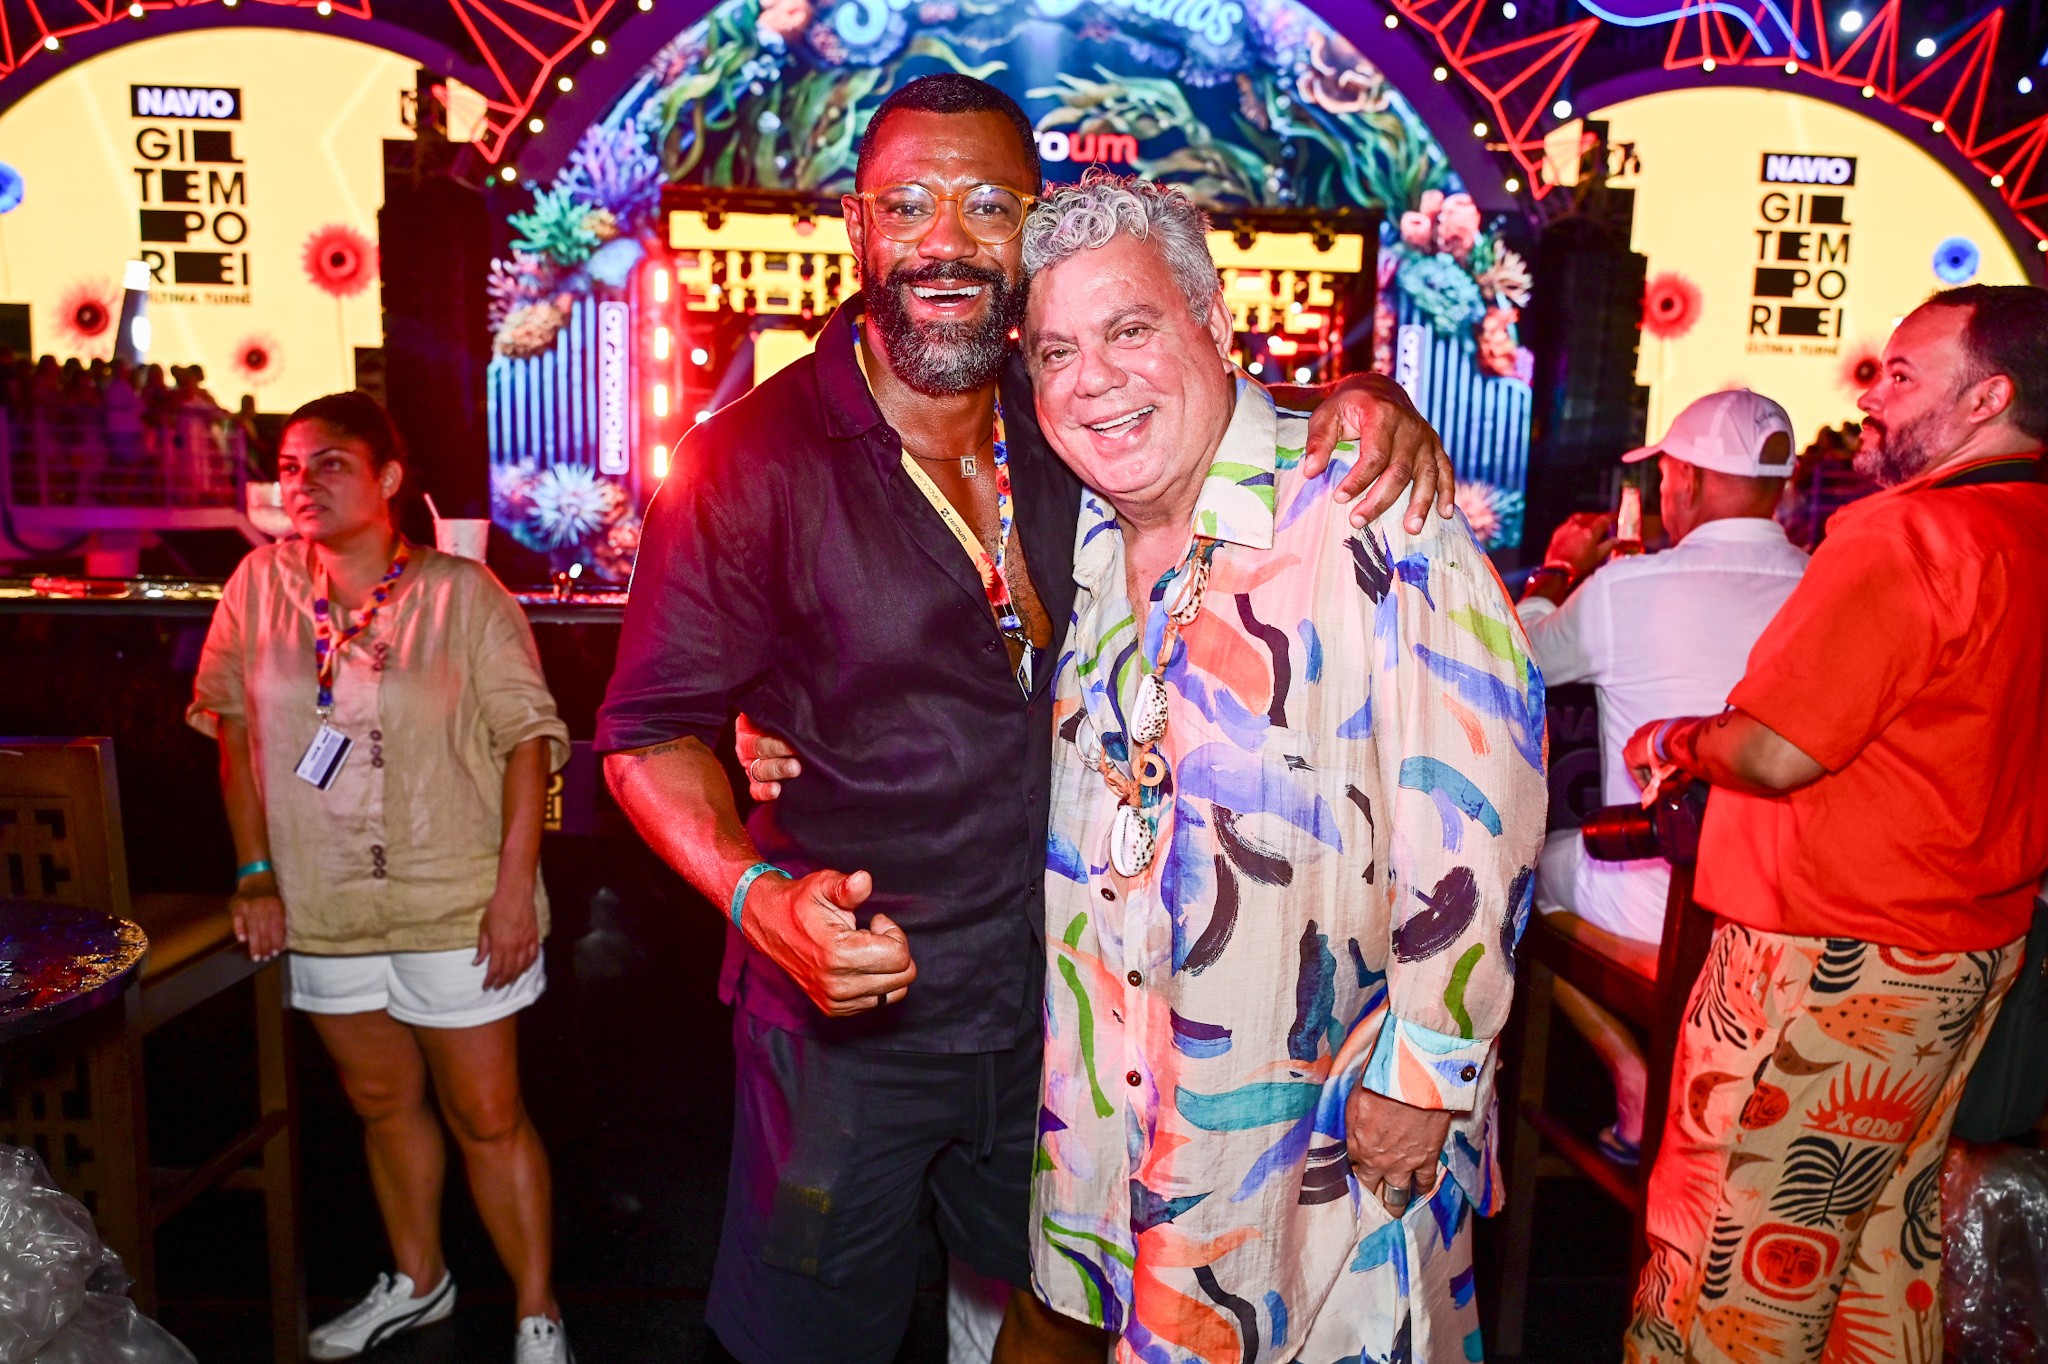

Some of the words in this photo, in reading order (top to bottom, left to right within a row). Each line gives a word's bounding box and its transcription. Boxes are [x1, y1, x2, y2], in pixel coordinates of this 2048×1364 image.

[137, 86, 235, 118] NAVIO
[135, 127, 244, 163] GIL
[1766, 155, 1851, 184] NAVIO
[1761, 192, 1852, 225] GIL
